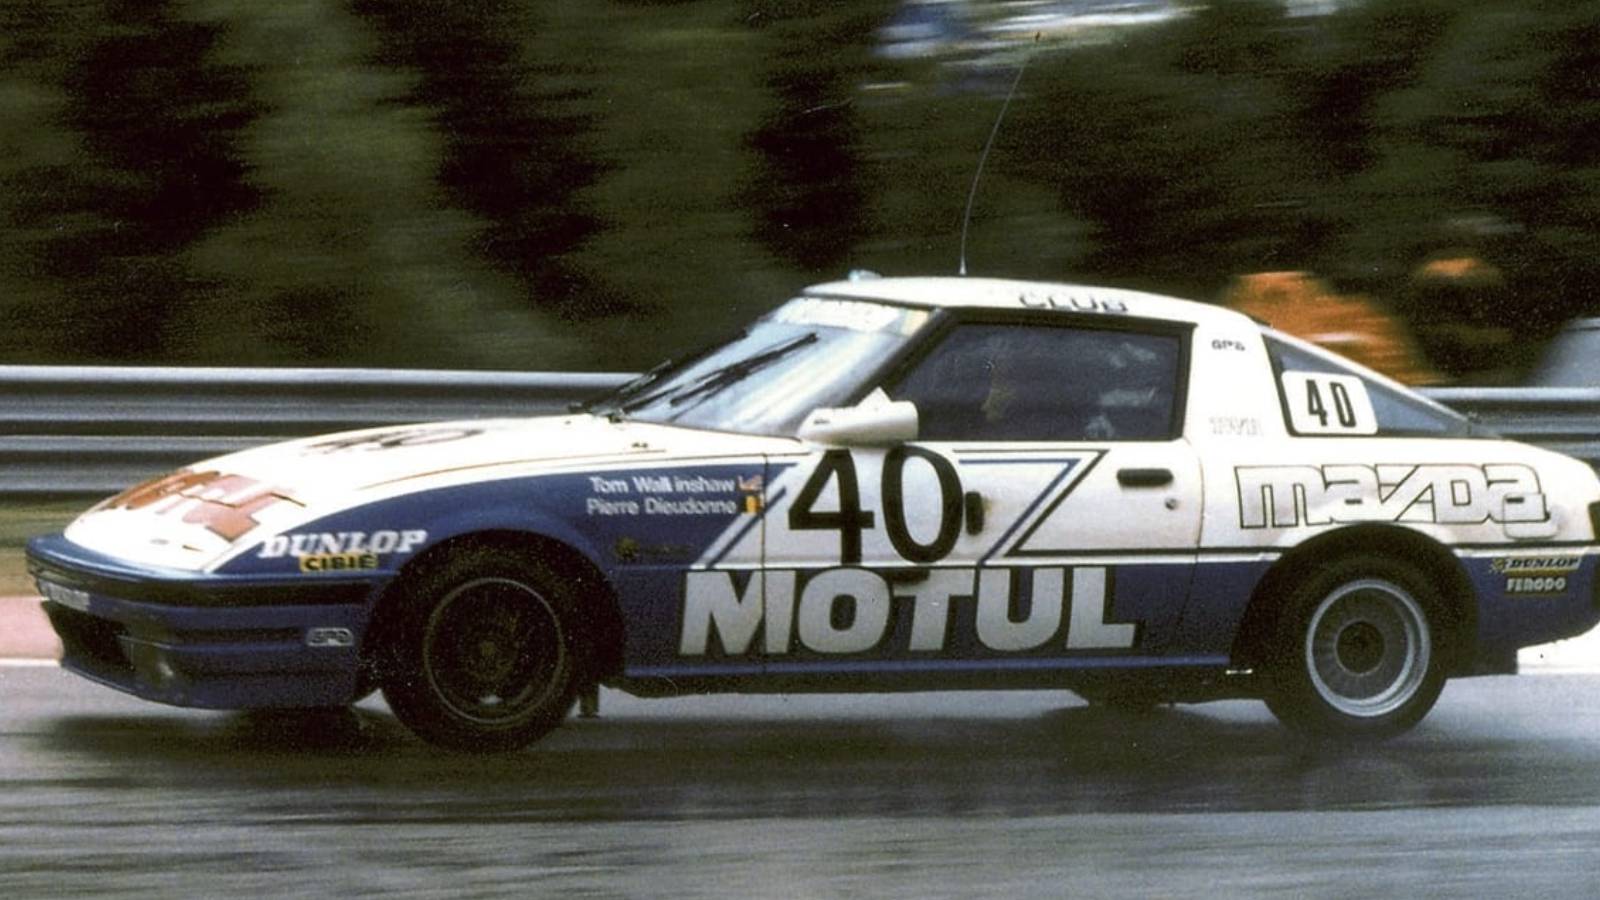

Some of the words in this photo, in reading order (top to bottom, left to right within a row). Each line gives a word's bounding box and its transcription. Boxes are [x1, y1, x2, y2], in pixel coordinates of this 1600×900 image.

[1305, 378, 1358, 428] 40
[589, 476, 629, 493] Tom
[586, 497, 639, 515] Pierre
[787, 444, 964, 566] 40
[256, 529, 428, 559] DUNLOP
[1508, 557, 1581, 569] DUNLOP
[1506, 577, 1566, 592] FERODO
[679, 566, 1136, 656] MOTUL
